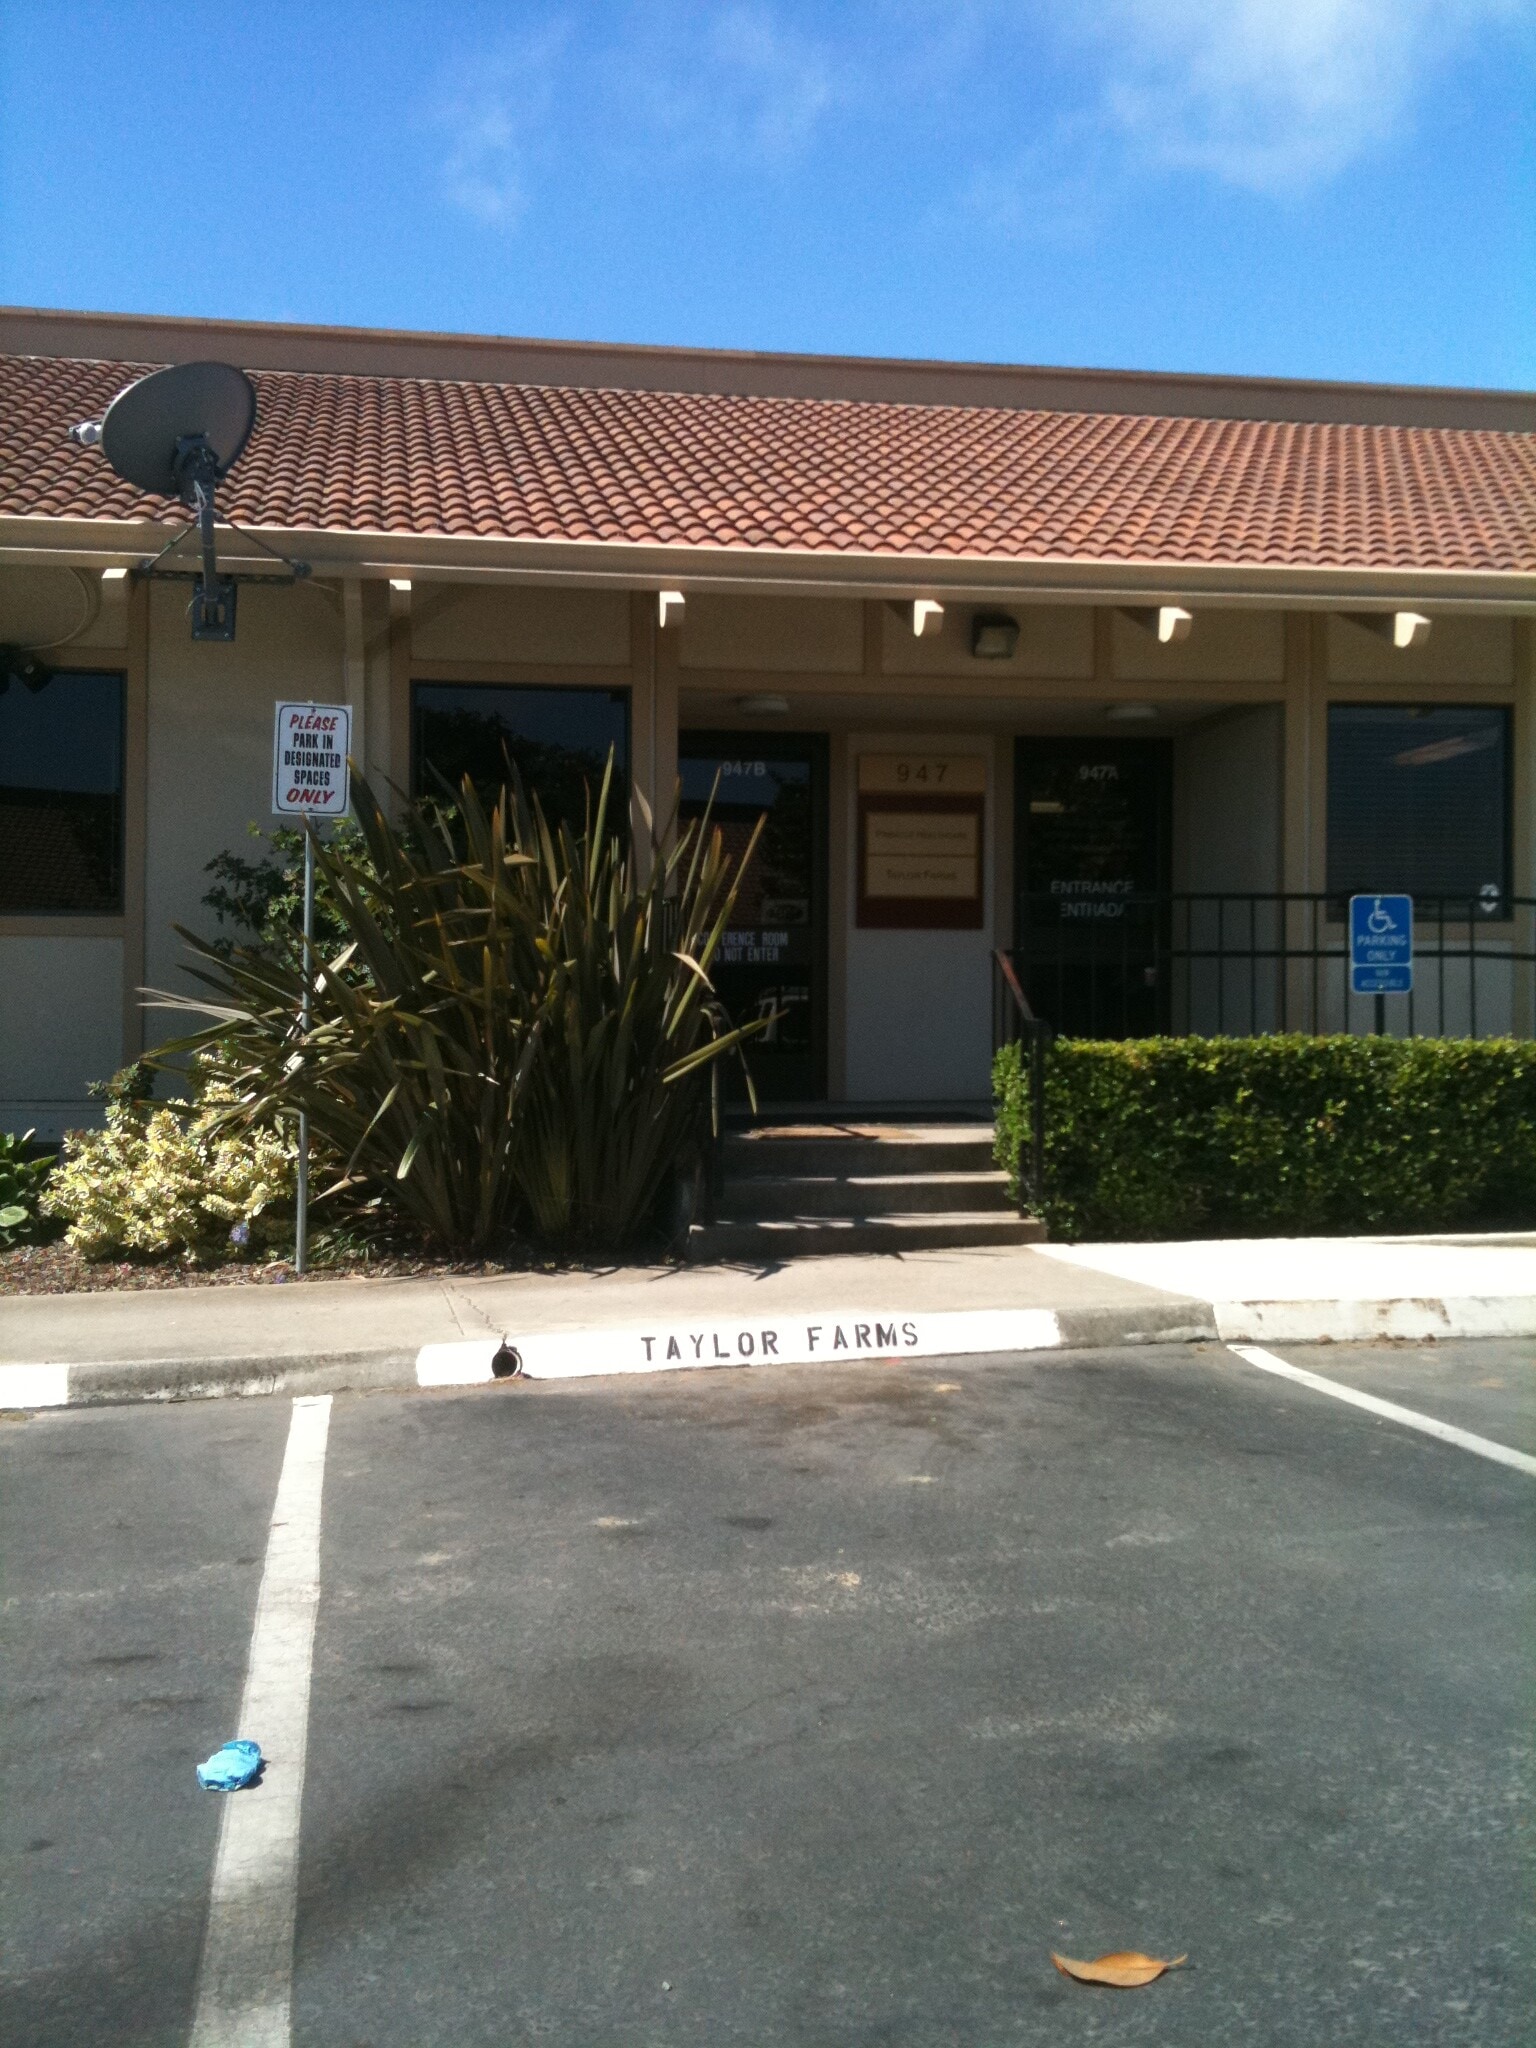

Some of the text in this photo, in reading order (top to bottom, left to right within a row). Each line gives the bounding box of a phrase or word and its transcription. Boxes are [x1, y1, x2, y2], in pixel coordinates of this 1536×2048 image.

[289, 714, 339, 731] PLEASE
[293, 733, 333, 750] PARK IN
[284, 751, 341, 768] DESIGNATED
[722, 761, 767, 776] 947B
[897, 763, 949, 783] 947
[1078, 765, 1119, 780] 947A
[294, 770, 330, 786] SPACES
[286, 788, 335, 804] ONLY
[1050, 880, 1135, 894] ENTRANCE
[698, 931, 789, 946] COERENCE ROOM
[1356, 935, 1408, 946] PARKING
[724, 947, 744, 961] NOT
[747, 947, 779, 961] ENTER
[1366, 950, 1398, 961] ONLY
[641, 1322, 918, 1361] TAYLOR FARMS
